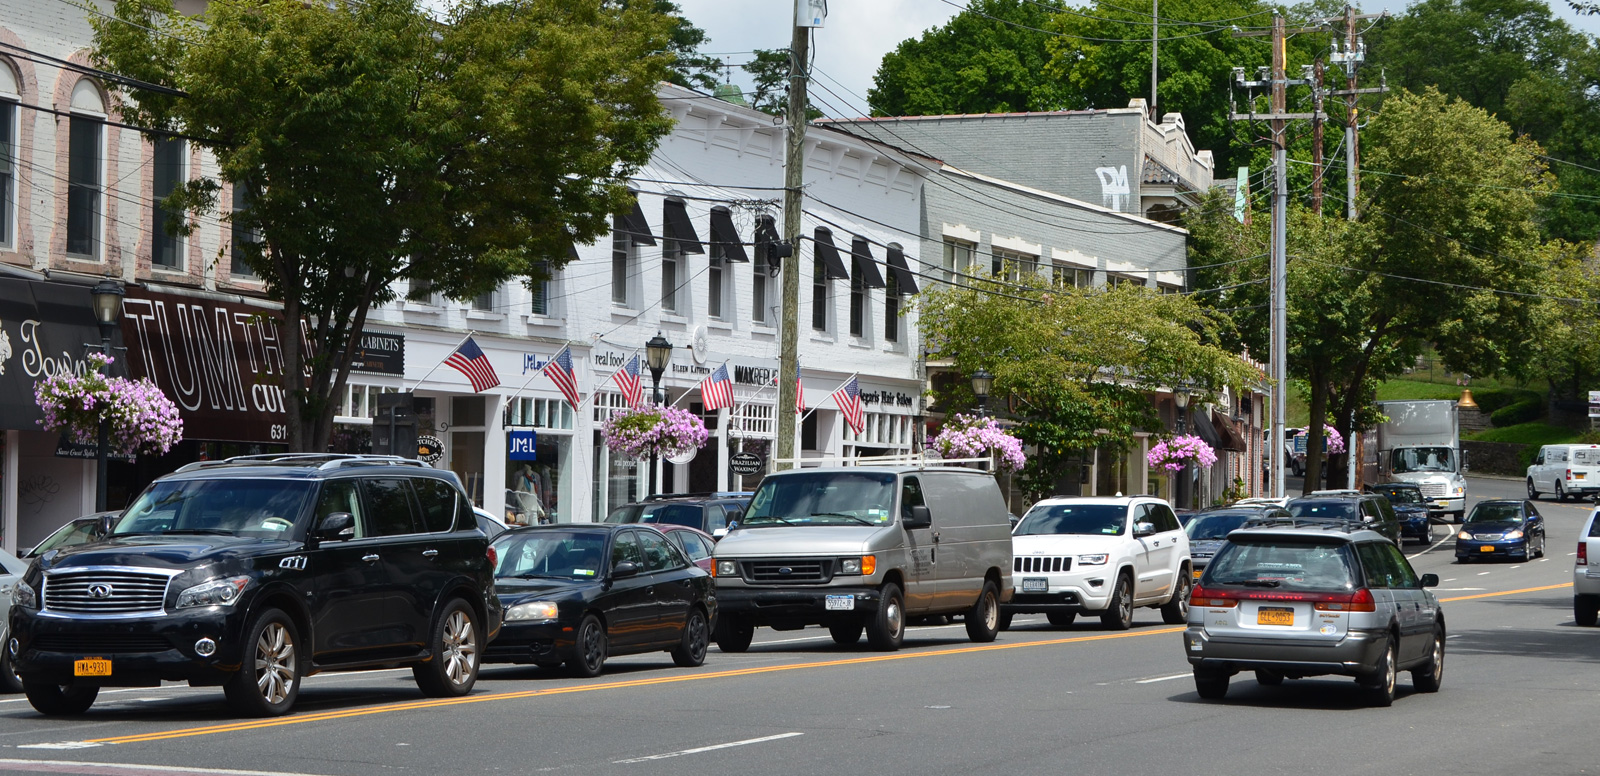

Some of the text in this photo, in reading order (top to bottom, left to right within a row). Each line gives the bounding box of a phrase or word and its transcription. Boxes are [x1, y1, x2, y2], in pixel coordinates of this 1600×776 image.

[360, 336, 399, 351] CABINETS
[122, 298, 247, 412] TUM
[595, 352, 608, 366] real
[609, 354, 625, 367] food
[672, 363, 689, 373] EILEEN
[690, 365, 711, 375] KATHRYN
[734, 364, 779, 387] WAXREPUB
[881, 390, 895, 405] Hair
[896, 391, 912, 406] Salon
[417, 439, 438, 448] TCHEN
[734, 465, 758, 473] WAXING
